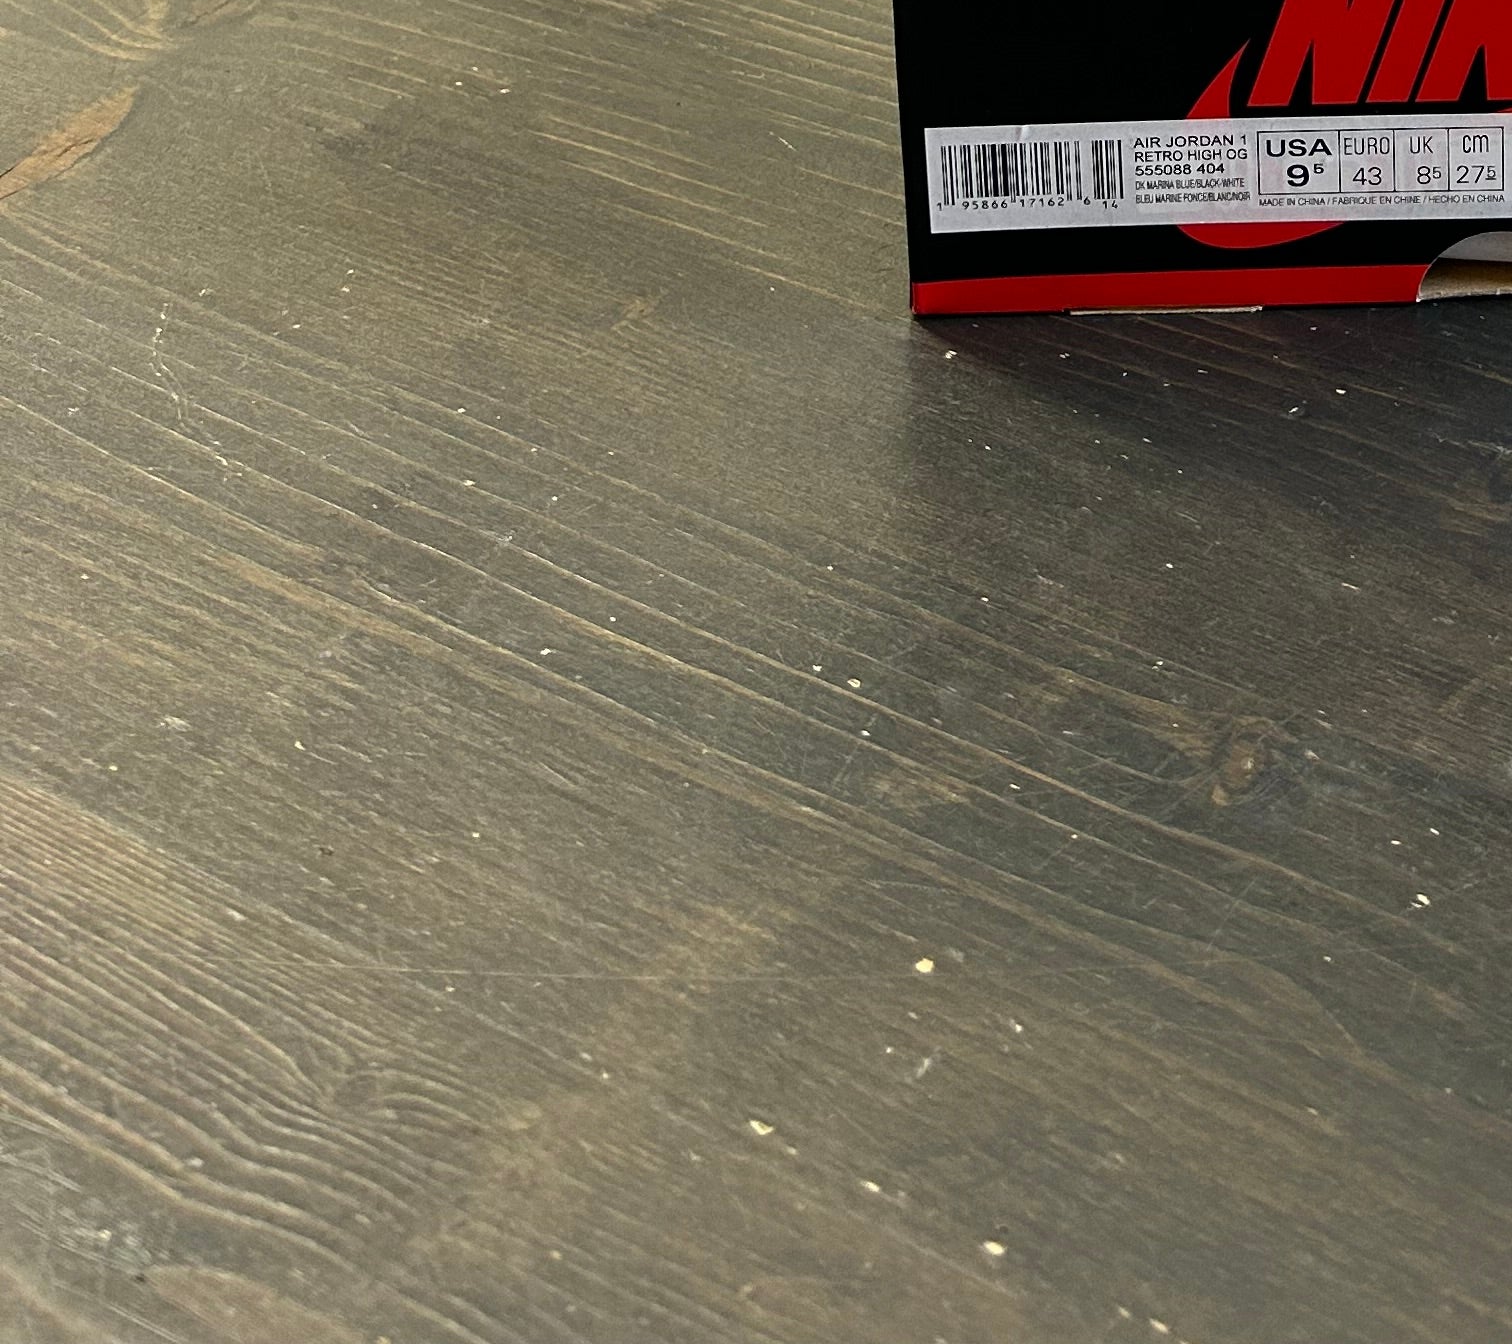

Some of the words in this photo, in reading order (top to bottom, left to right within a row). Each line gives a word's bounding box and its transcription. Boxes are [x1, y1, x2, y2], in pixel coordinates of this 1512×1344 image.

[1133, 136, 1161, 148] AIR
[1166, 135, 1234, 148] JORDAN
[1240, 134, 1247, 145] 1
[1265, 138, 1333, 158] USA
[1344, 136, 1390, 156] EURO
[1409, 135, 1433, 155] UK
[1134, 150, 1183, 162] RETRO
[1188, 149, 1222, 161] HIGH
[1226, 148, 1248, 160] OG
[1135, 163, 1192, 176] 555088
[1197, 163, 1225, 174] 404
[1352, 167, 1382, 186] 43
[937, 202, 943, 211] 1
[961, 200, 1008, 210] 95866
[1019, 197, 1065, 207] 17162
[1083, 196, 1091, 205] 6
[1102, 200, 1119, 209] 14
[1259, 198, 1284, 206] MADE
[1298, 197, 1326, 206] CHINA
[1332, 196, 1377, 205] FABRIQUE
[1380, 196, 1392, 204] EN
[1394, 195, 1421, 204] CHINE
[1429, 194, 1460, 204] HECHO
[1463, 194, 1475, 203] EN
[1477, 194, 1505, 203] CHINA
